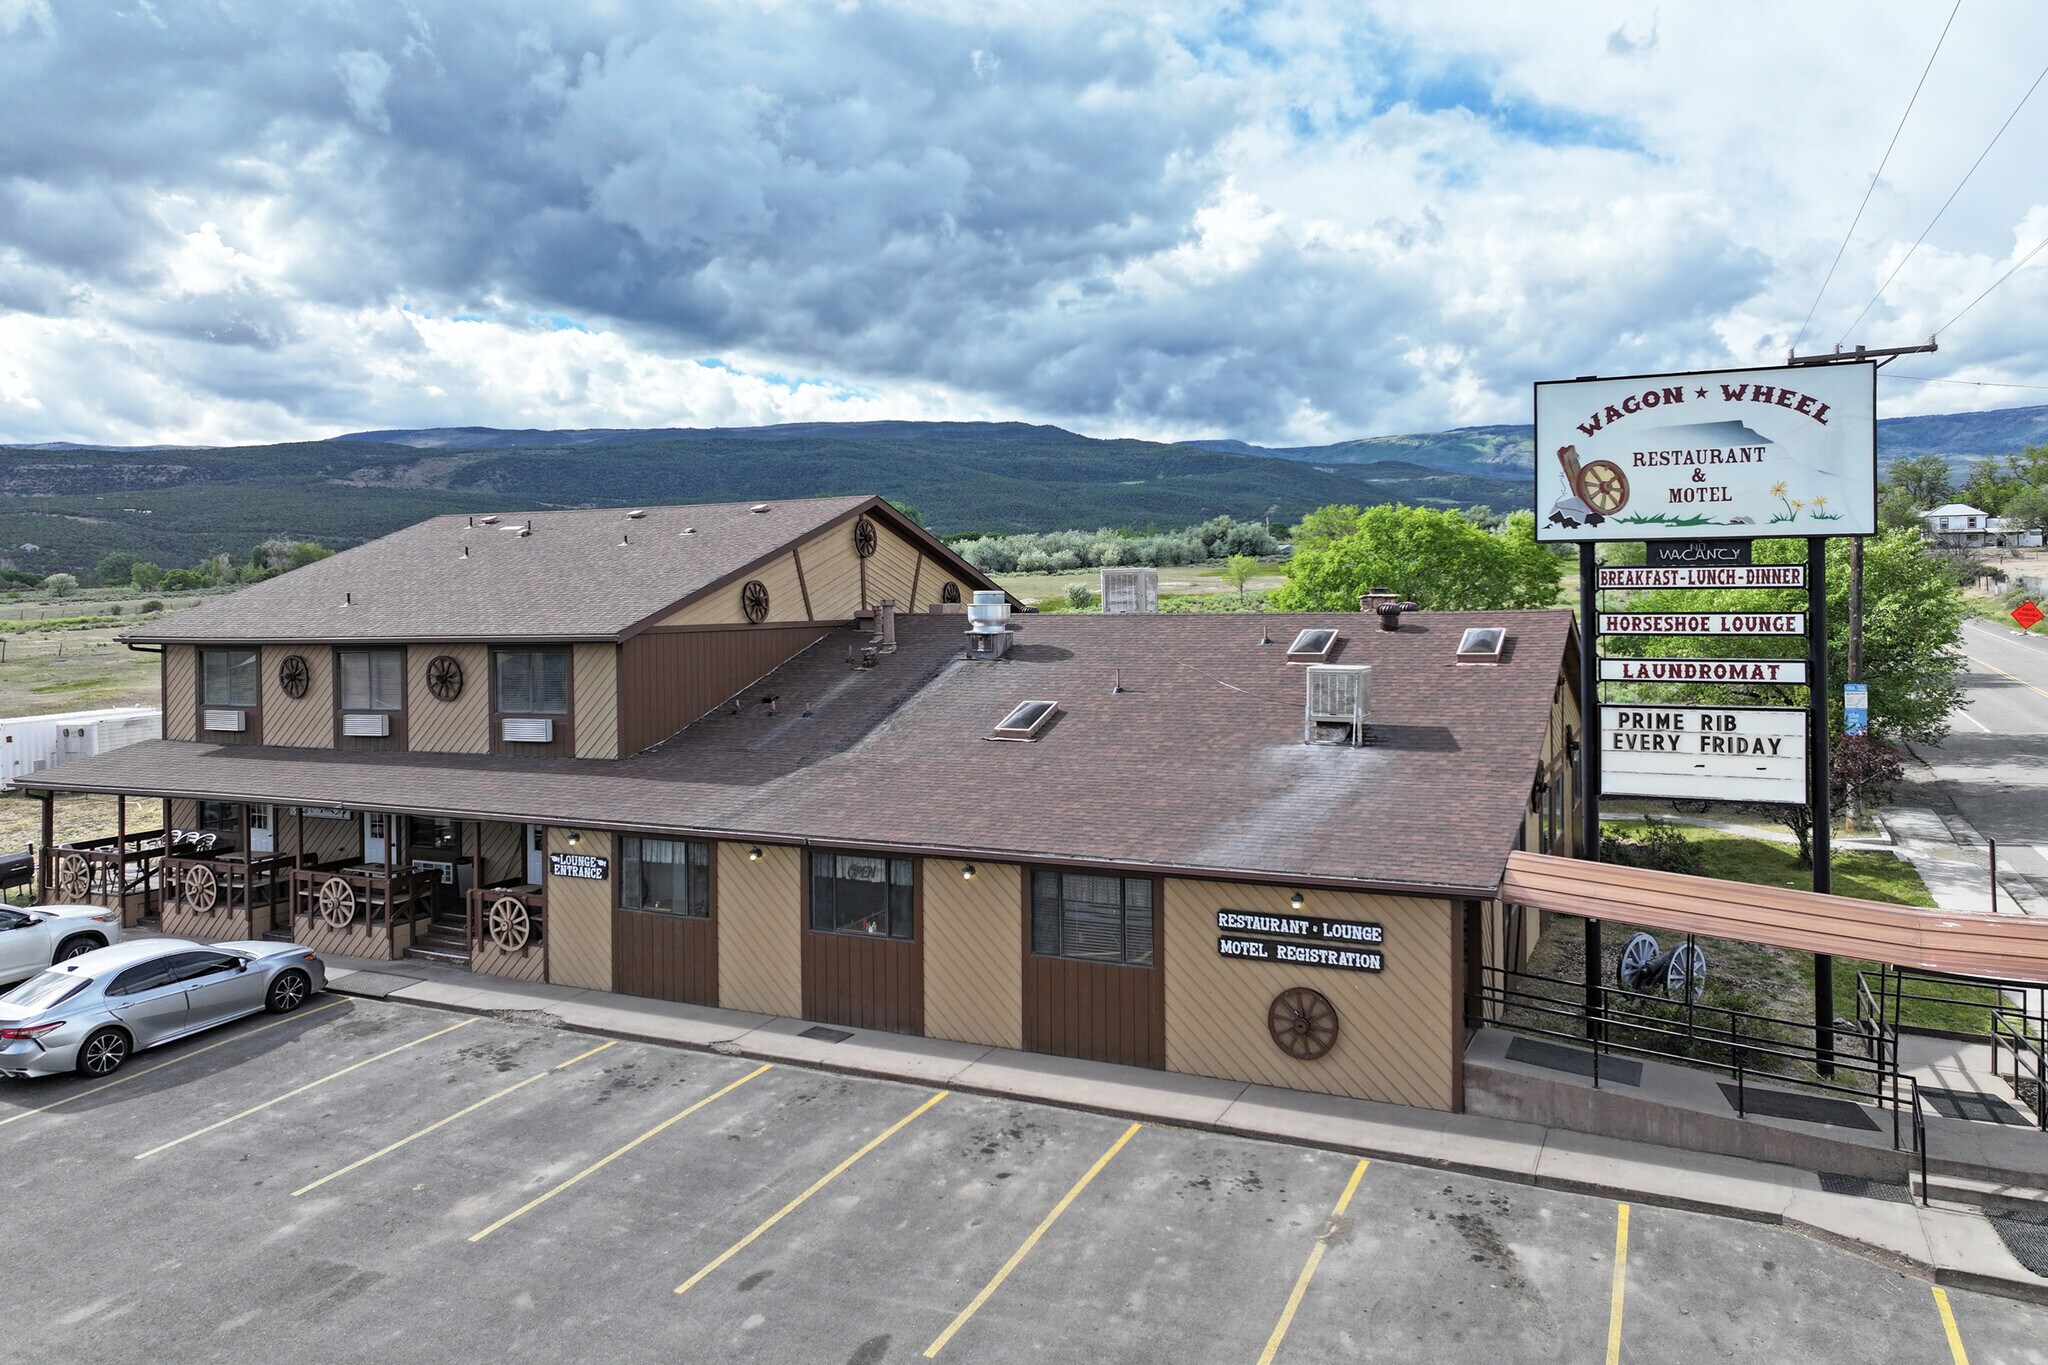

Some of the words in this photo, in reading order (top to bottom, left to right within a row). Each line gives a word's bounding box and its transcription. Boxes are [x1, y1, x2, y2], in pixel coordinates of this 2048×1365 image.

[1576, 386, 1685, 437] WAGON
[1720, 384, 1832, 426] WHEEL
[1633, 447, 1766, 467] RESTAURANT
[1692, 468, 1706, 483] &
[1668, 486, 1733, 504] MOTEL
[1659, 548, 1740, 561] VACANCY
[1606, 616, 1711, 632] HORSESHOE
[1720, 616, 1797, 632] LOUNGE
[1622, 663, 1780, 681] LAUNDROMAT
[1618, 712, 1684, 730] PRIME
[1701, 714, 1737, 732] RIB
[1613, 733, 1681, 751] EVERY
[1701, 736, 1781, 755] FRIDAY
[560, 854, 596, 867] LOUNGE
[554, 864, 602, 878] ENTRANCE
[847, 864, 877, 880] OPEN
[1218, 912, 1309, 935] RESTAURANT
[1322, 922, 1382, 942] LOUNGE
[1220, 939, 1268, 958] MOTEL
[1276, 945, 1381, 970] REGISTRATION
